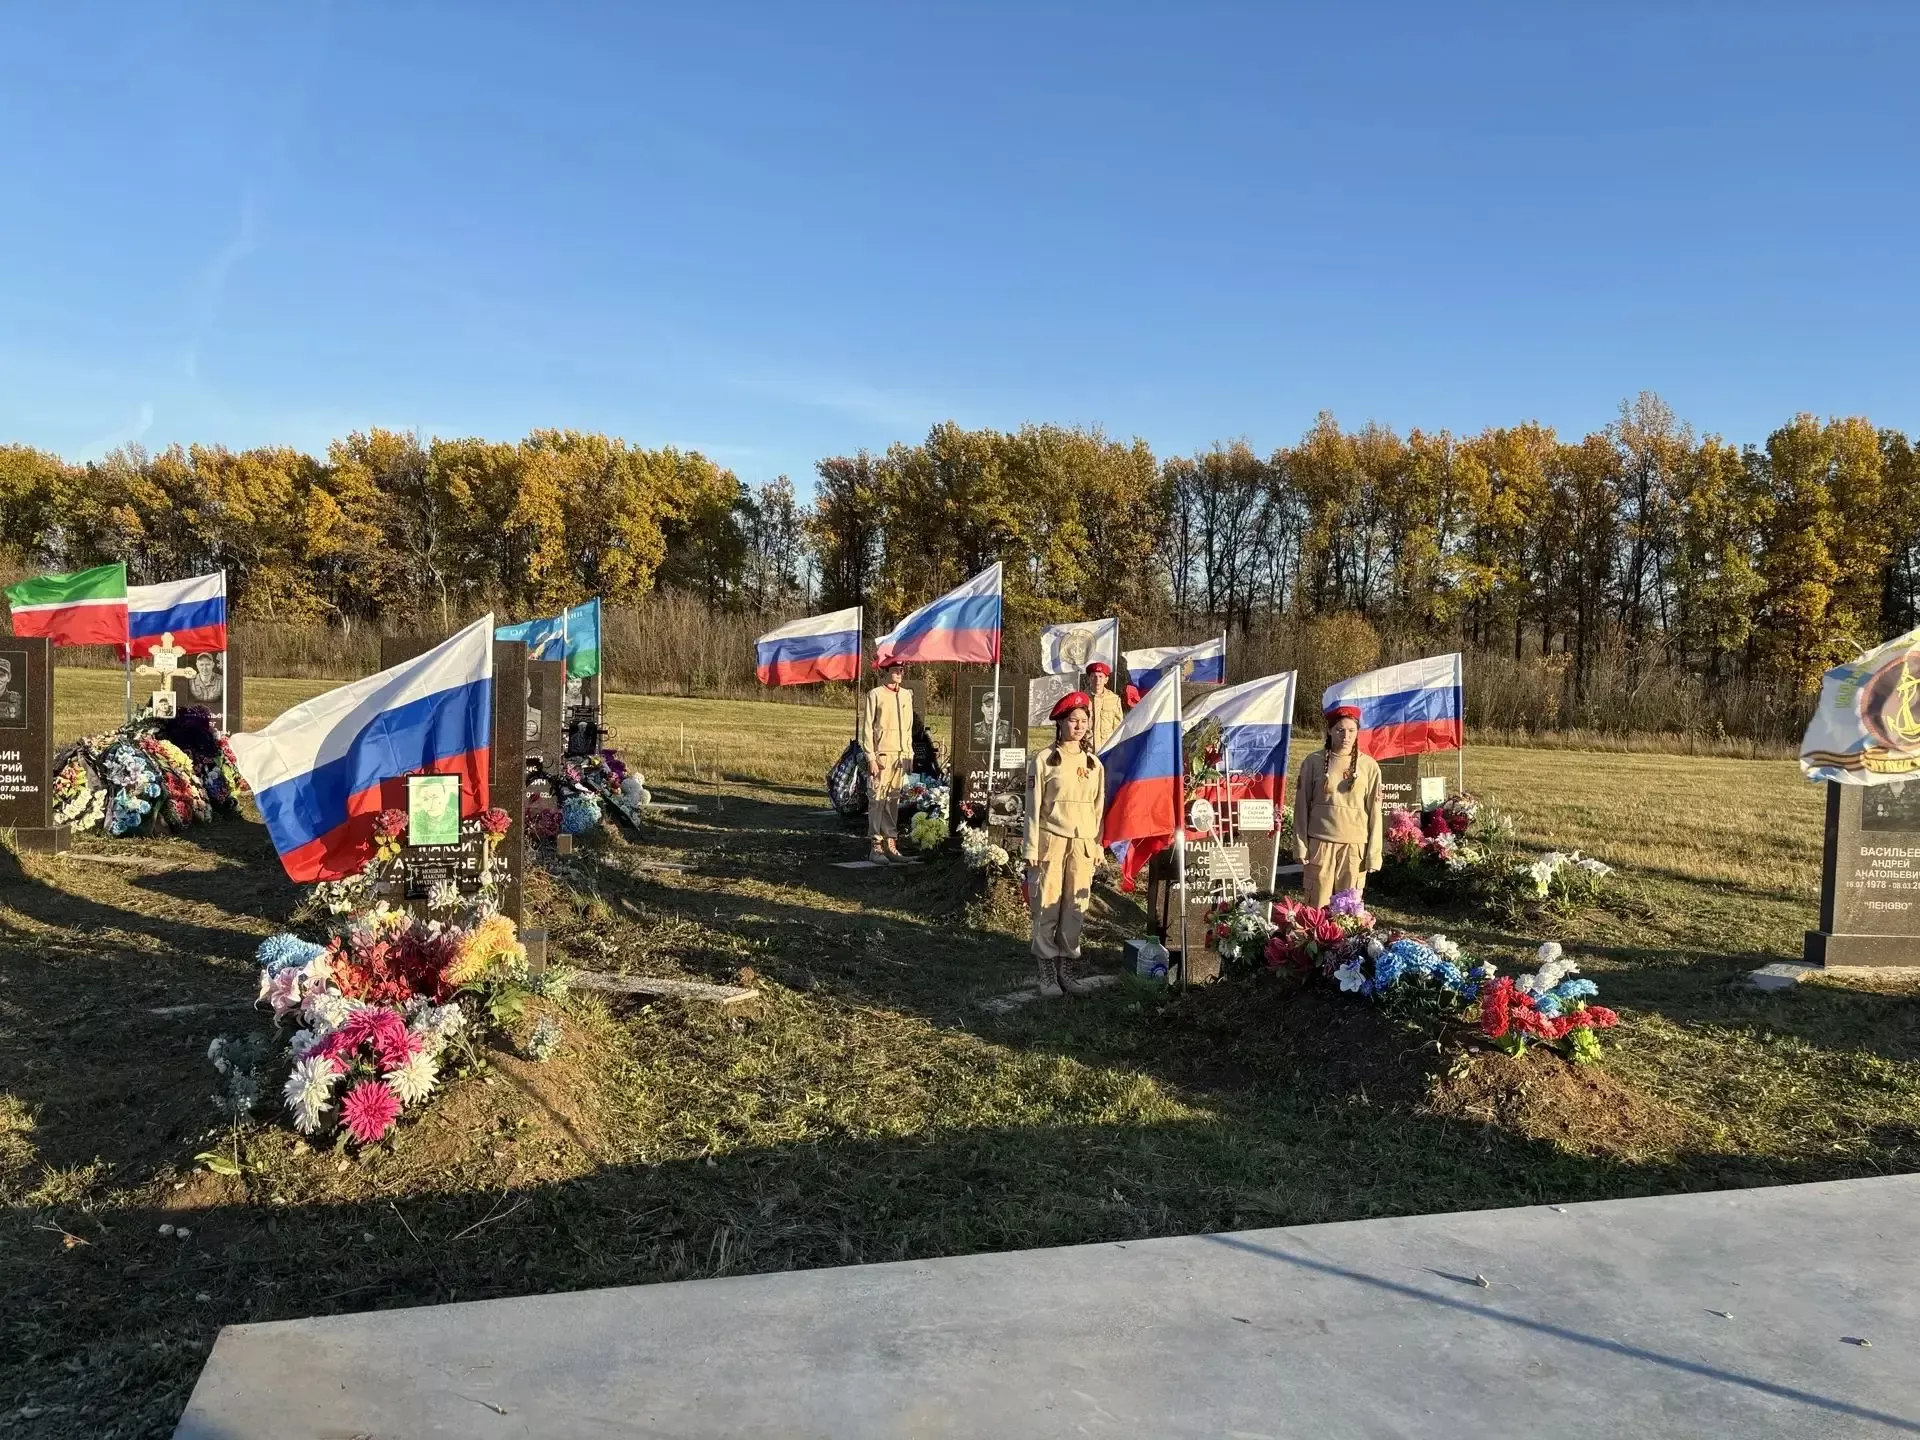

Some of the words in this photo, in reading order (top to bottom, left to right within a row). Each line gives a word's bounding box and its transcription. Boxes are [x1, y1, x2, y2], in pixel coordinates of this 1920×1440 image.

[1860, 846, 1920, 858] ВАСИЛЬЕВ
[1871, 858, 1910, 869] АНДРЕЙ
[1855, 869, 1920, 880] АНАТОЛЬЕВИ
